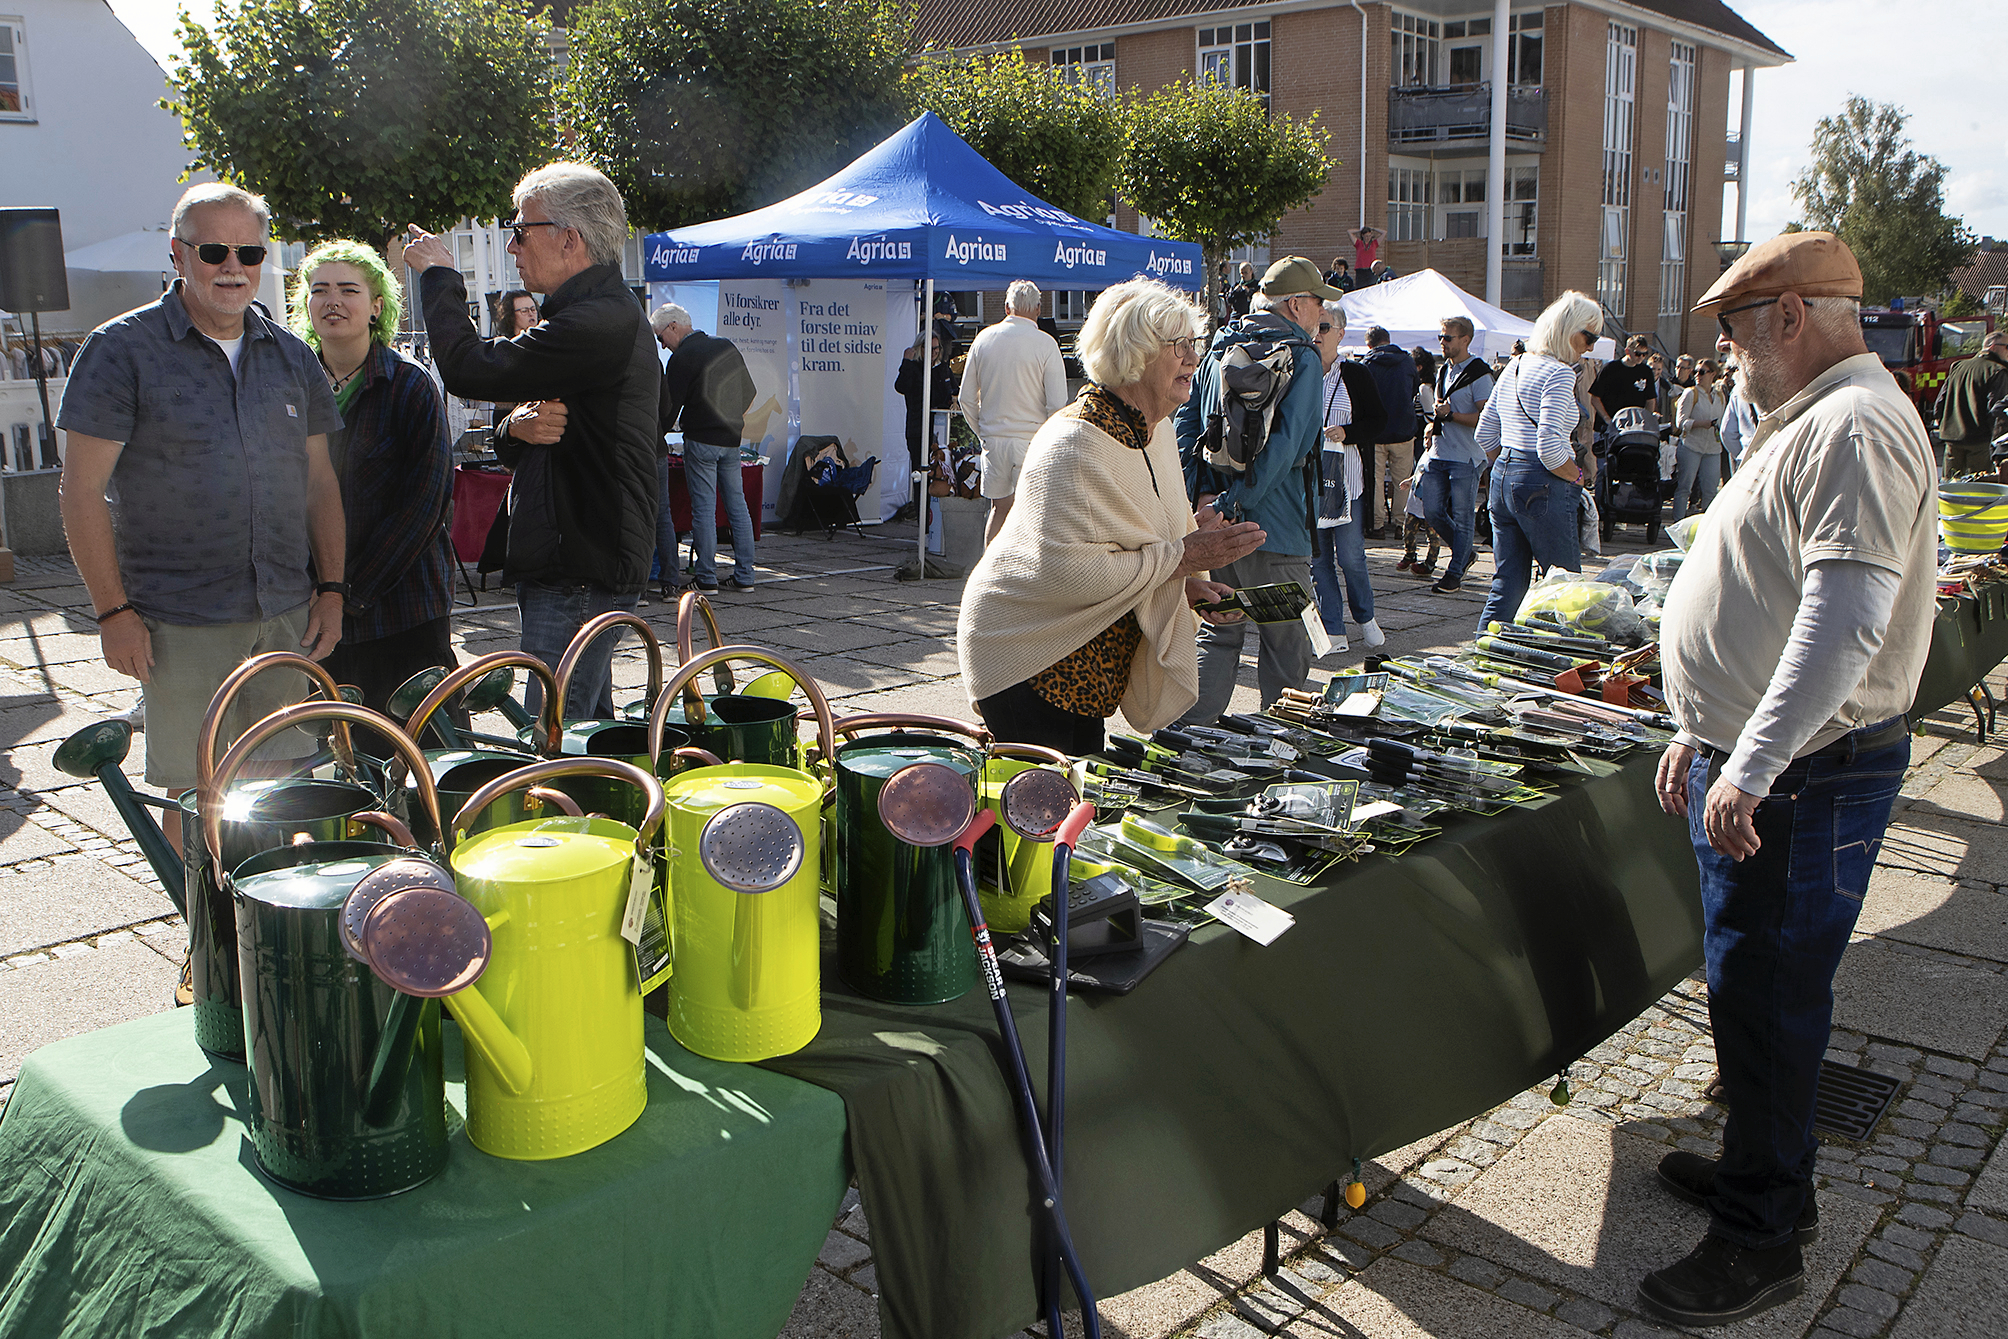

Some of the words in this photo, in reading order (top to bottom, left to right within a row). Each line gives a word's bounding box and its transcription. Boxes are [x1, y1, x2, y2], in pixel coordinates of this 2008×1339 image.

[977, 200, 1058, 222] Agria
[650, 243, 689, 269] Agria
[741, 239, 786, 266] Agria
[846, 235, 897, 265] Agria
[945, 234, 994, 265] Agria
[1054, 240, 1096, 269] Agria
[1145, 250, 1183, 277] Agria
[863, 283, 879, 291] Agria
[724, 292, 735, 307] Vi
[736, 293, 780, 311] forsikrer
[800, 301, 824, 316] Fra
[828, 301, 850, 317] det
[723, 311, 740, 326] alle
[742, 312, 762, 330] dyr.
[800, 319, 842, 335] første
[844, 321, 879, 336] miav
[1863, 315, 1880, 323] 112
[800, 338, 815, 353] til
[818, 338, 841, 354] det
[844, 339, 882, 354] sidste
[802, 357, 845, 372] kram.
[978, 947, 1000, 1000] JACKSON
[987, 946, 1004, 986] SPEAR
[999, 988, 1007, 998] &
